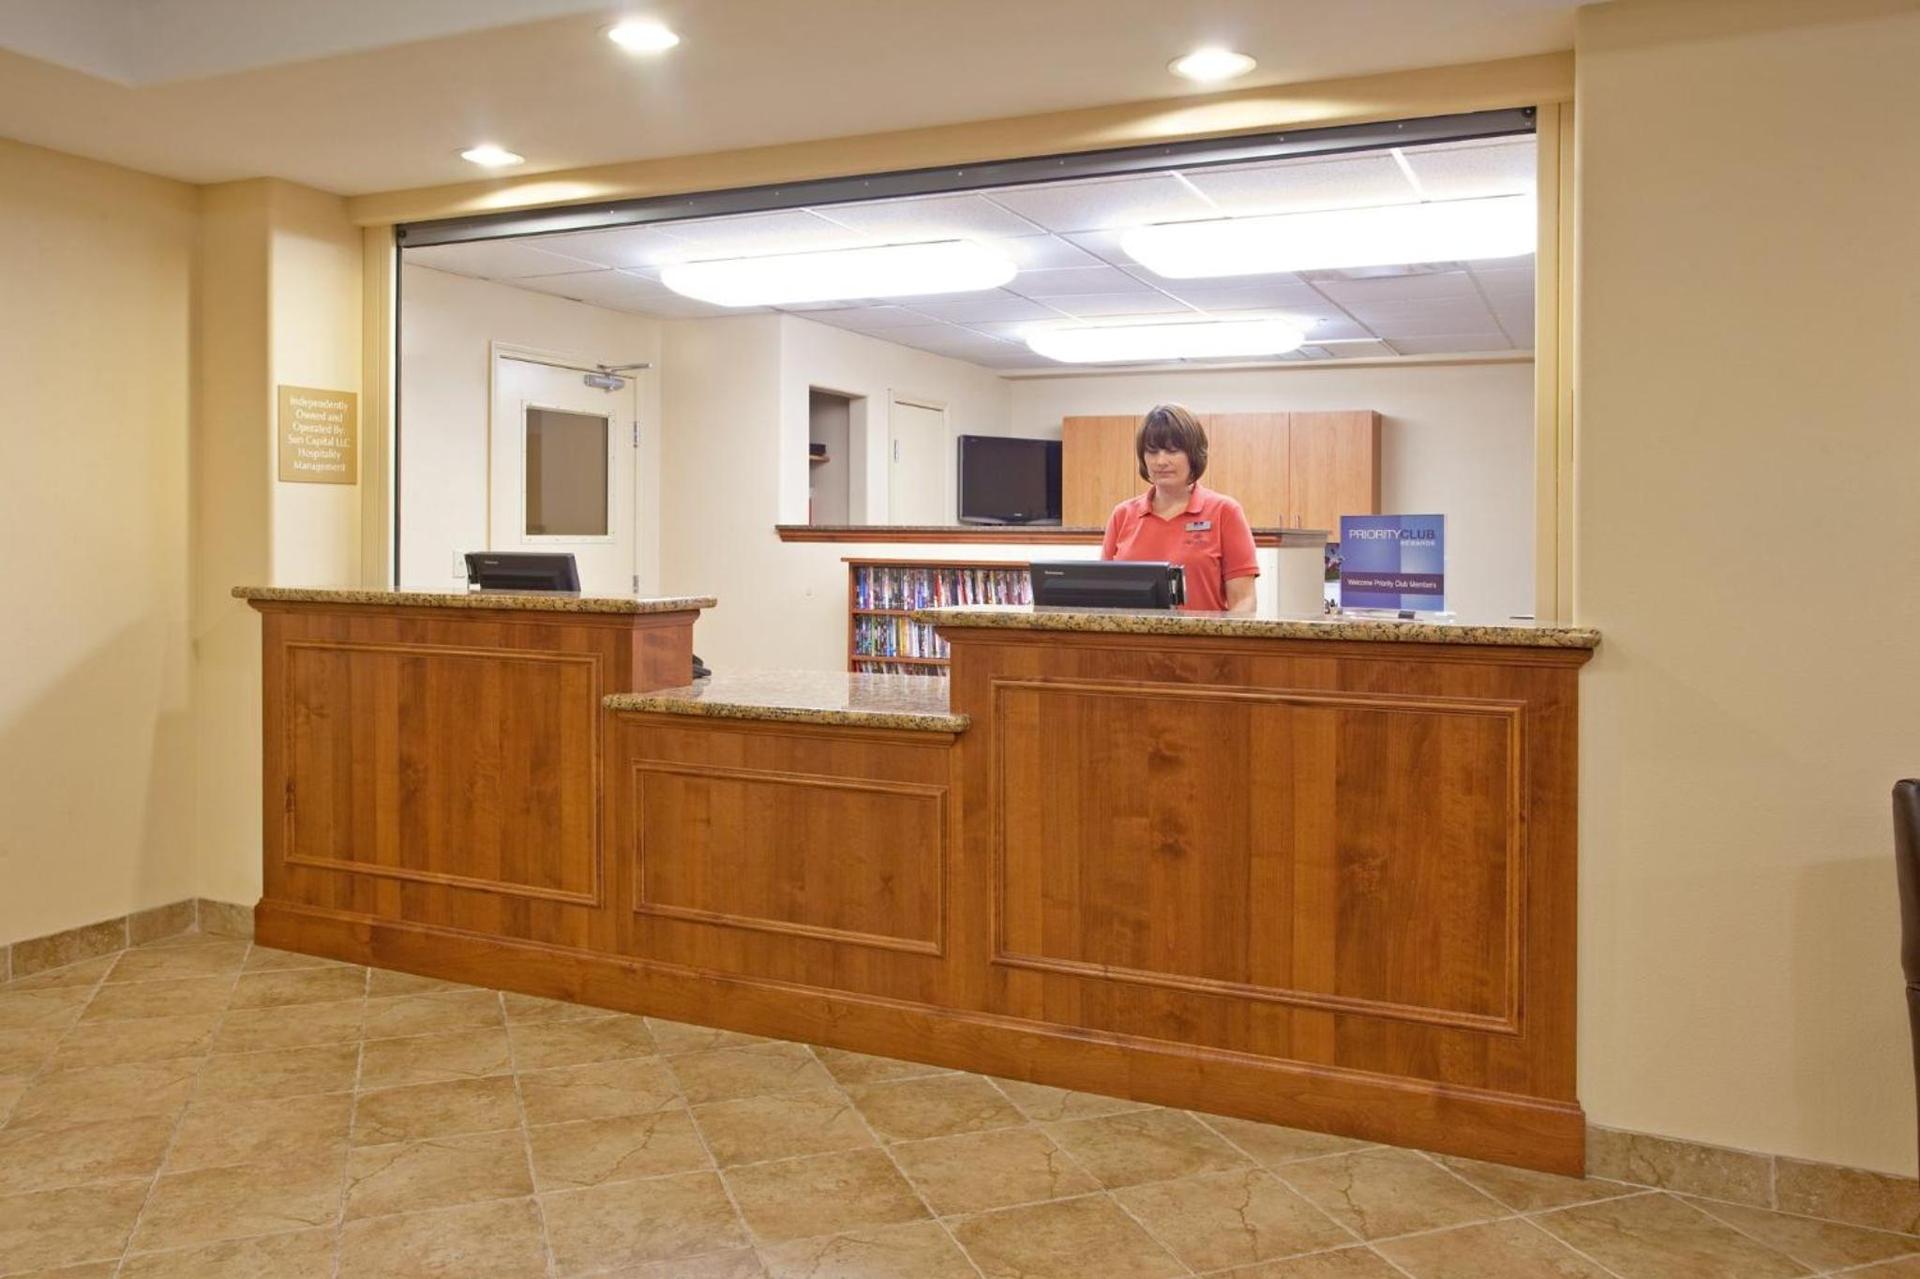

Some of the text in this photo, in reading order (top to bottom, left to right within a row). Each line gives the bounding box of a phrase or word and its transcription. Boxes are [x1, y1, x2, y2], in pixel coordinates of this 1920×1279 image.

[289, 396, 349, 411] Independently
[295, 409, 343, 423] Owned and
[292, 422, 332, 435] Operated
[305, 435, 334, 448] Capital
[298, 447, 341, 461] Hospitality
[293, 461, 346, 473] Management
[1347, 579, 1437, 589] Welcome Priority Club Members
